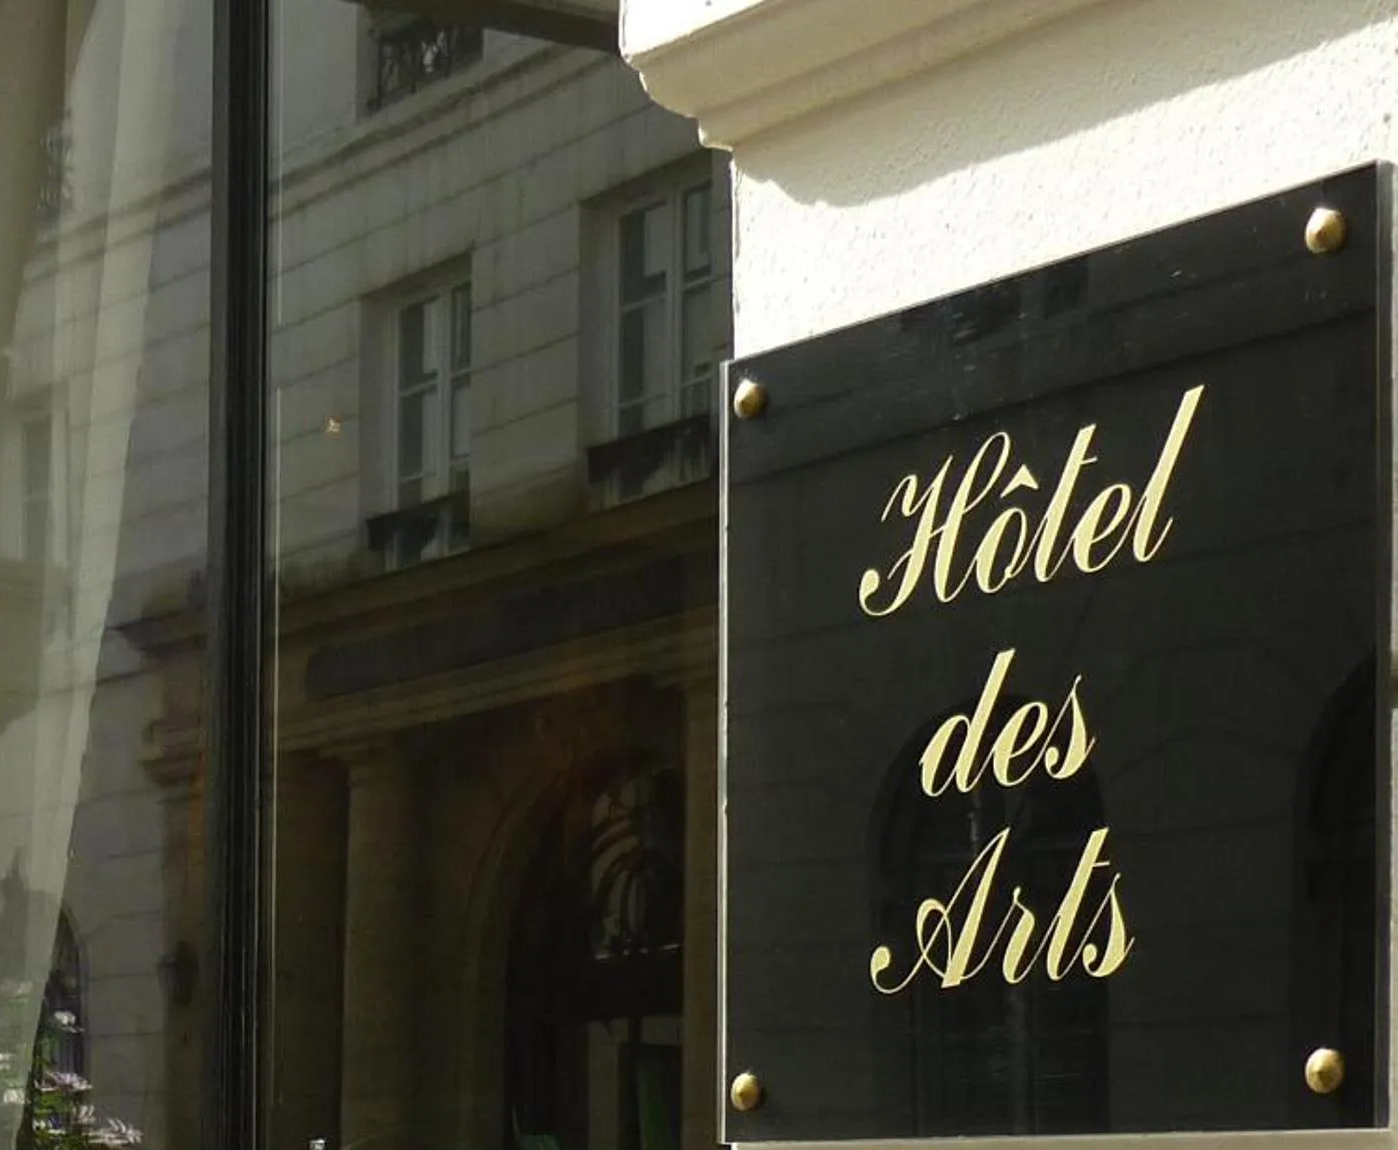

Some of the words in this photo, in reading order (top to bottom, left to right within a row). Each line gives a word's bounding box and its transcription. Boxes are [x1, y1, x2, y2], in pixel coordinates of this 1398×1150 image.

[859, 385, 1204, 616] Hôtel
[919, 648, 1095, 797] des
[870, 827, 1135, 994] Arts
